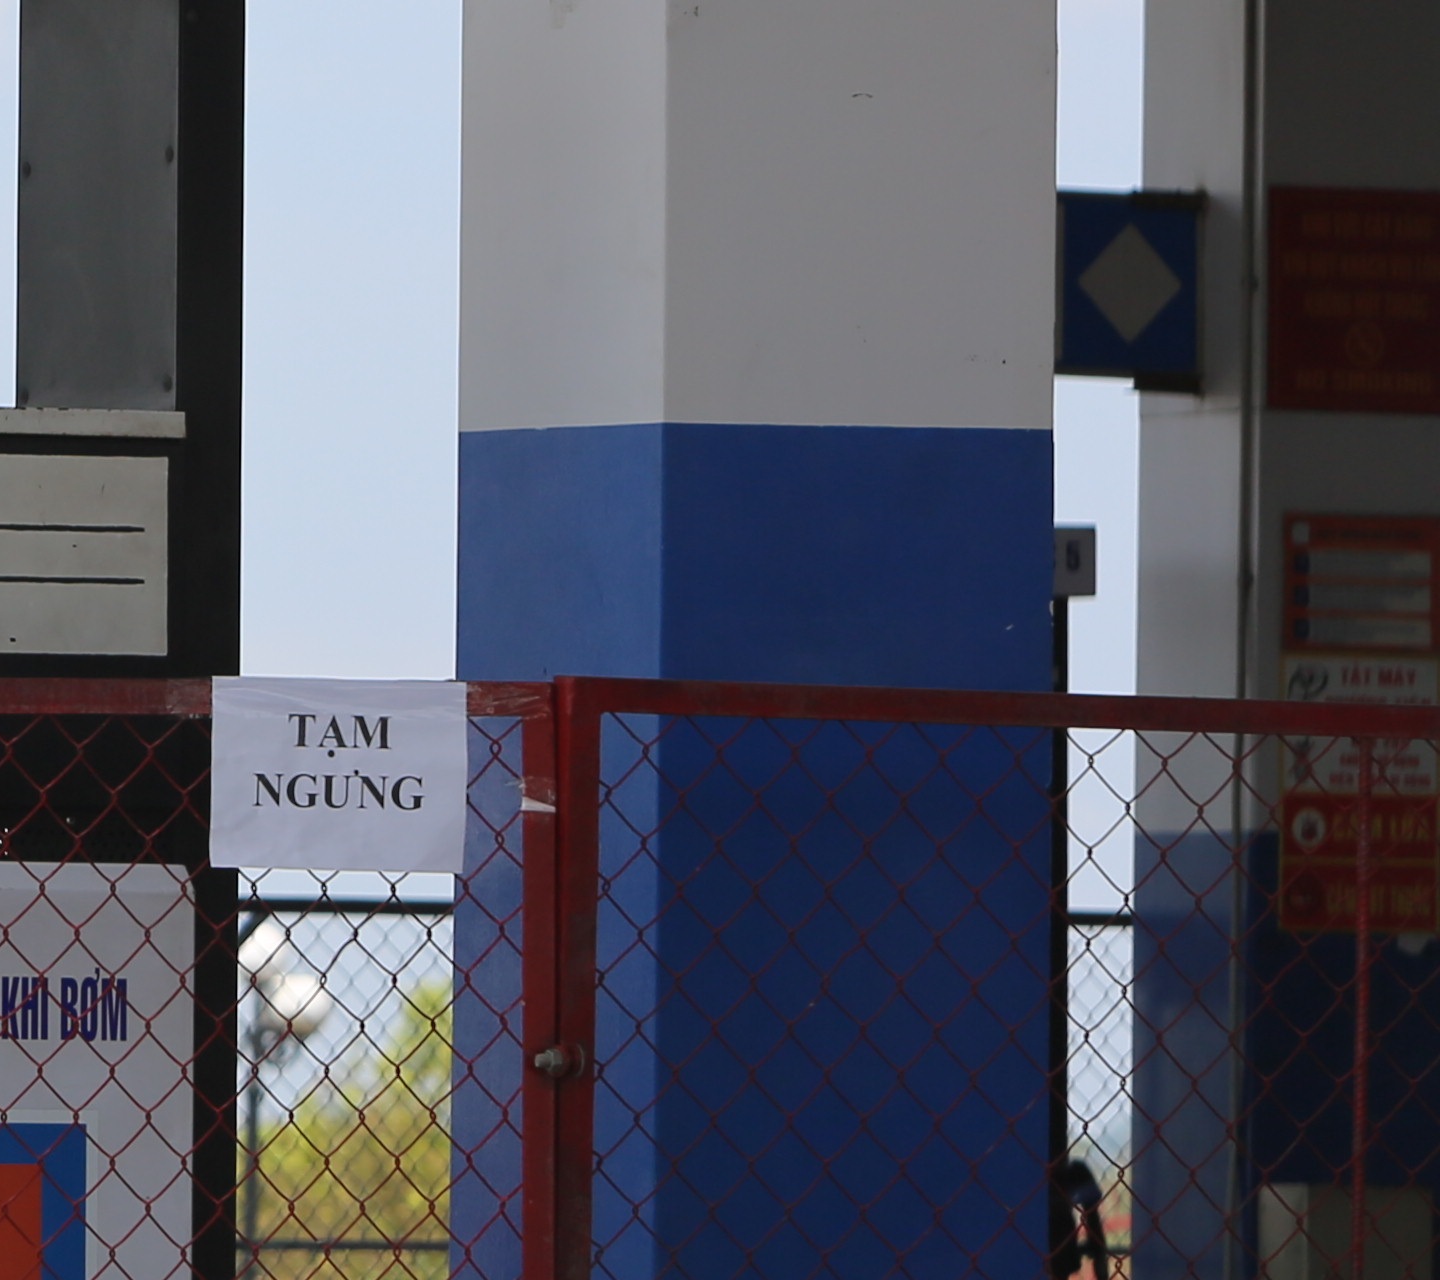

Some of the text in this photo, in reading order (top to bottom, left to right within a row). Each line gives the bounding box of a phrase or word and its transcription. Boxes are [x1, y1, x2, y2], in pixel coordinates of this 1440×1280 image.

[287, 713, 392, 758] TẠM
[252, 770, 425, 811] NGƯNG
[1, 976, 49, 1040] KHI
[59, 966, 128, 1042] BƠM
